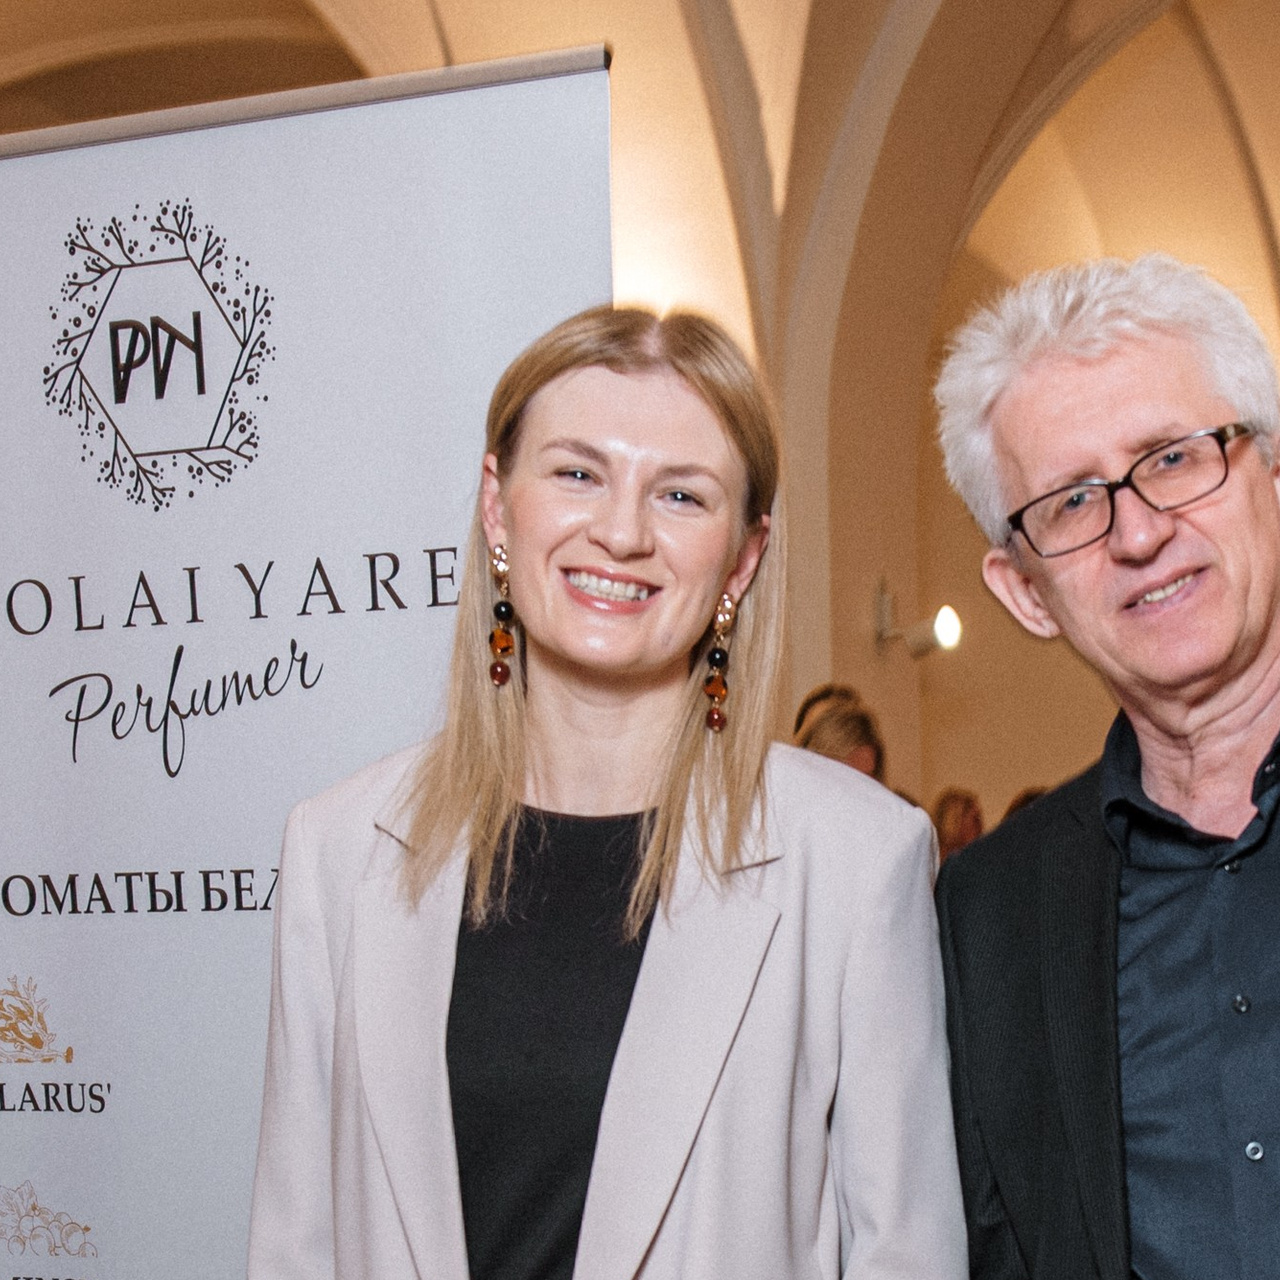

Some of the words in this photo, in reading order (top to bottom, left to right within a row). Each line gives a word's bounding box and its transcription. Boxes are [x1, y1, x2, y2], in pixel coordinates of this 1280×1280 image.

[6, 566, 205, 635] OLAI
[234, 547, 461, 619] YARE
[48, 638, 324, 778] Perfumer
[1, 872, 188, 916] ОМАТЫ
